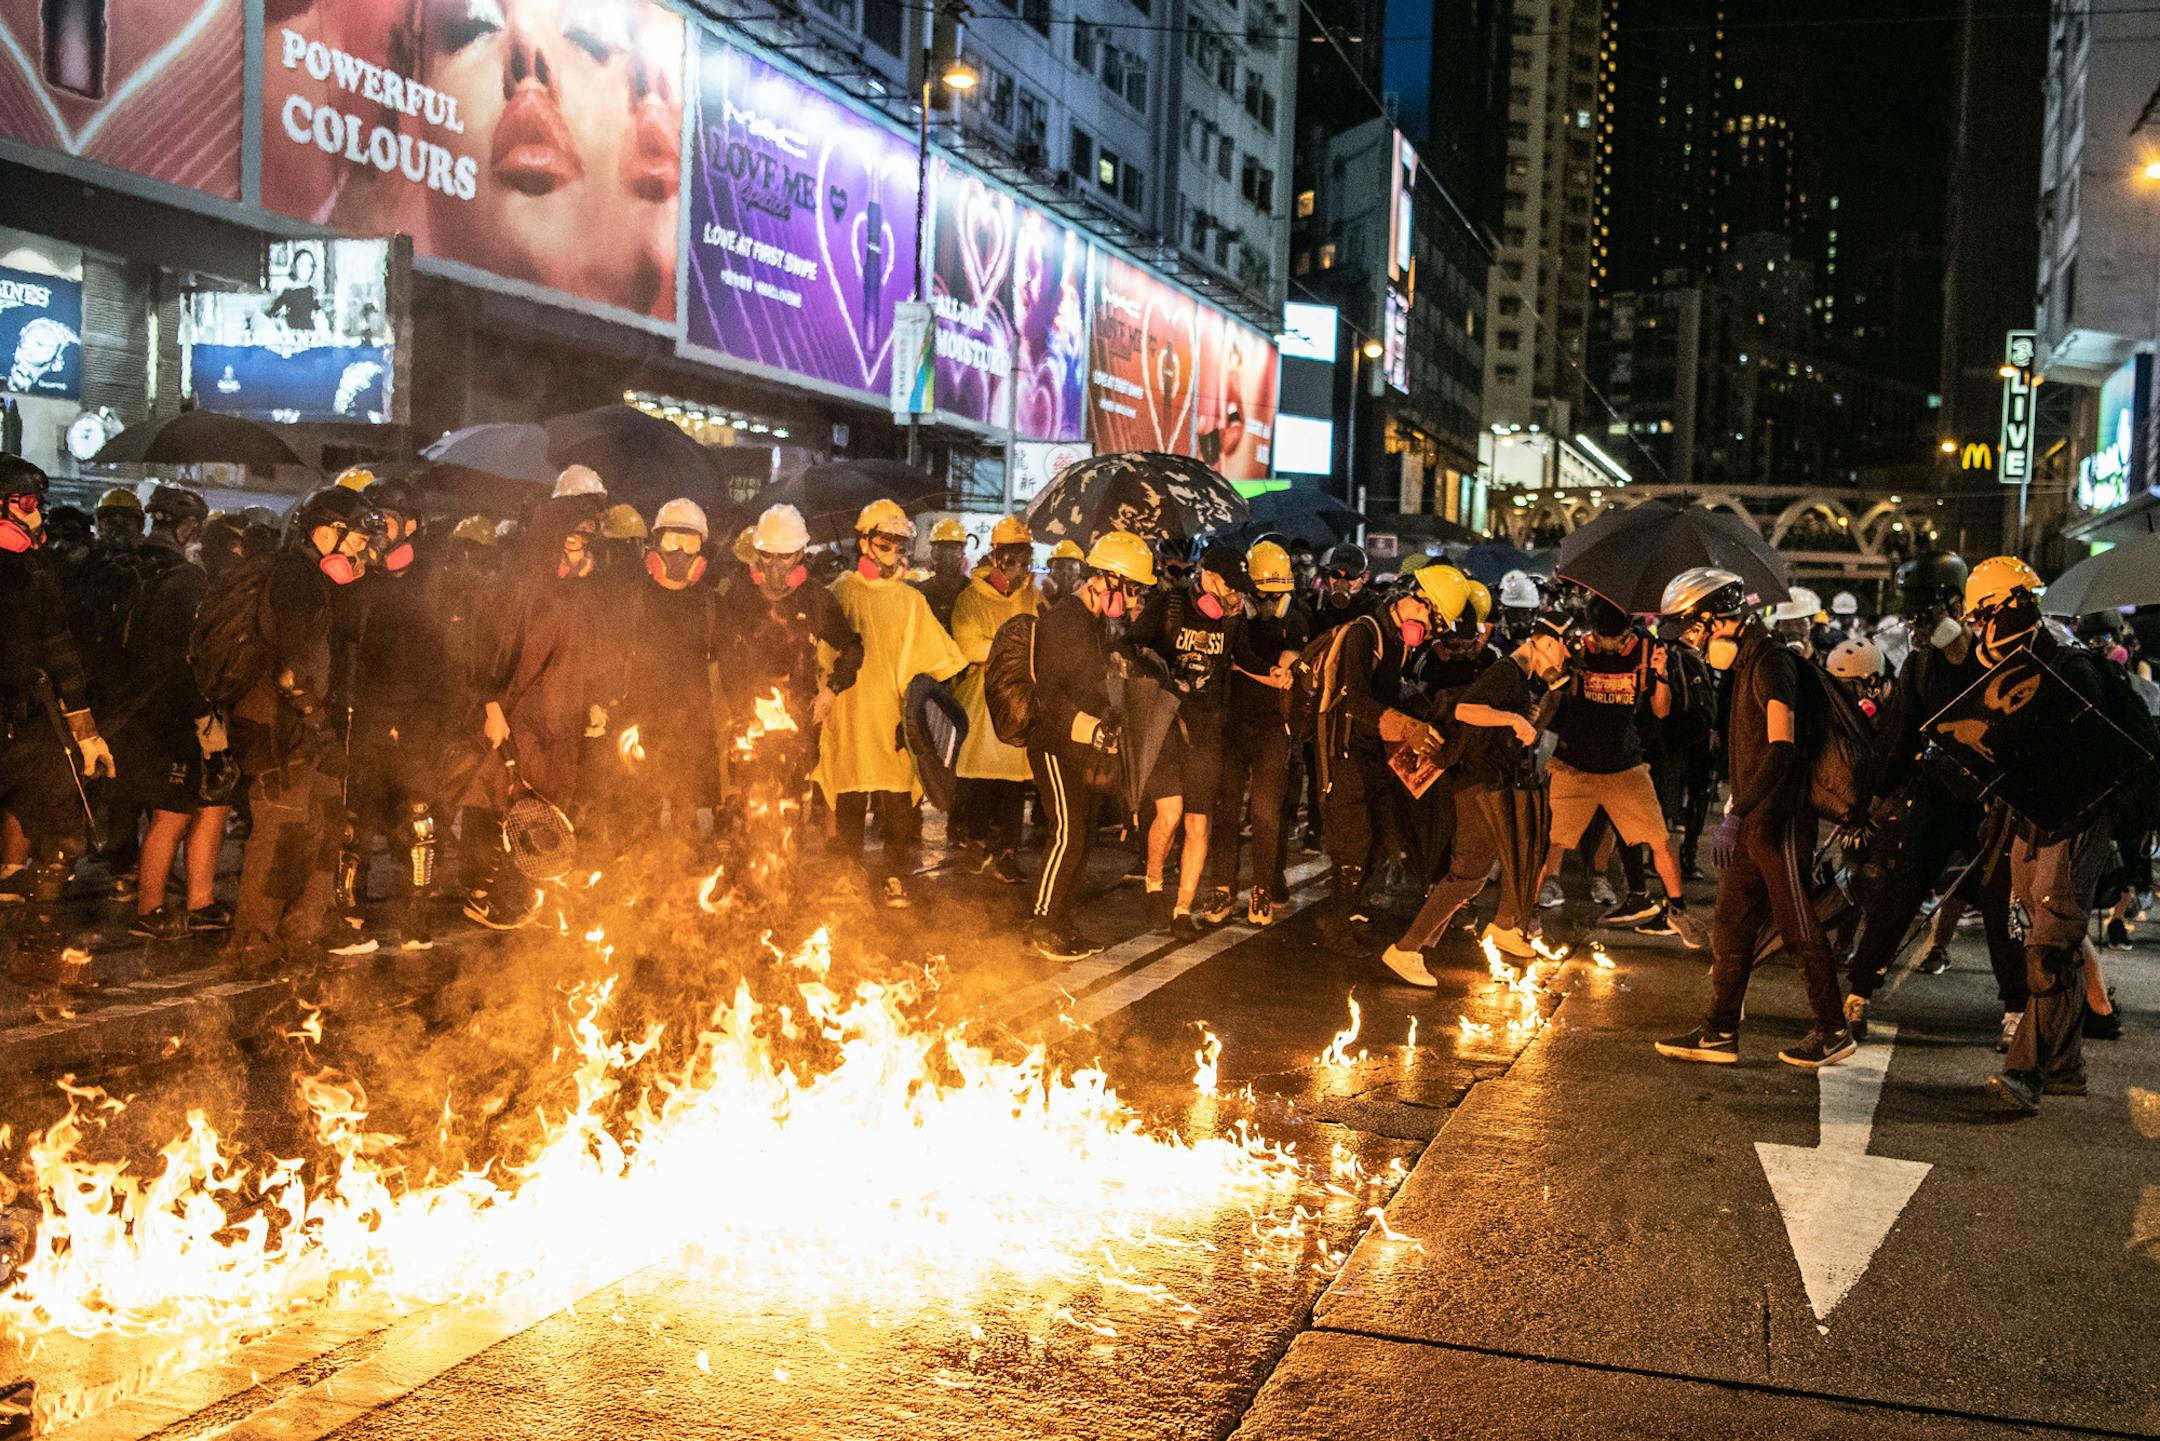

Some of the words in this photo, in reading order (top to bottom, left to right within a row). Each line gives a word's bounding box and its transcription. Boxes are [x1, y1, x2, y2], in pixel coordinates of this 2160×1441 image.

[281, 28, 465, 134] POWERFUL
[281, 94, 479, 200] COLOURS
[711, 129, 778, 190] LOVE
[703, 221, 738, 253] LOVE
[752, 240, 785, 269] FIRST
[2006, 369, 2029, 476] LIVE
[1584, 690, 1635, 705] WORLDWIDE
